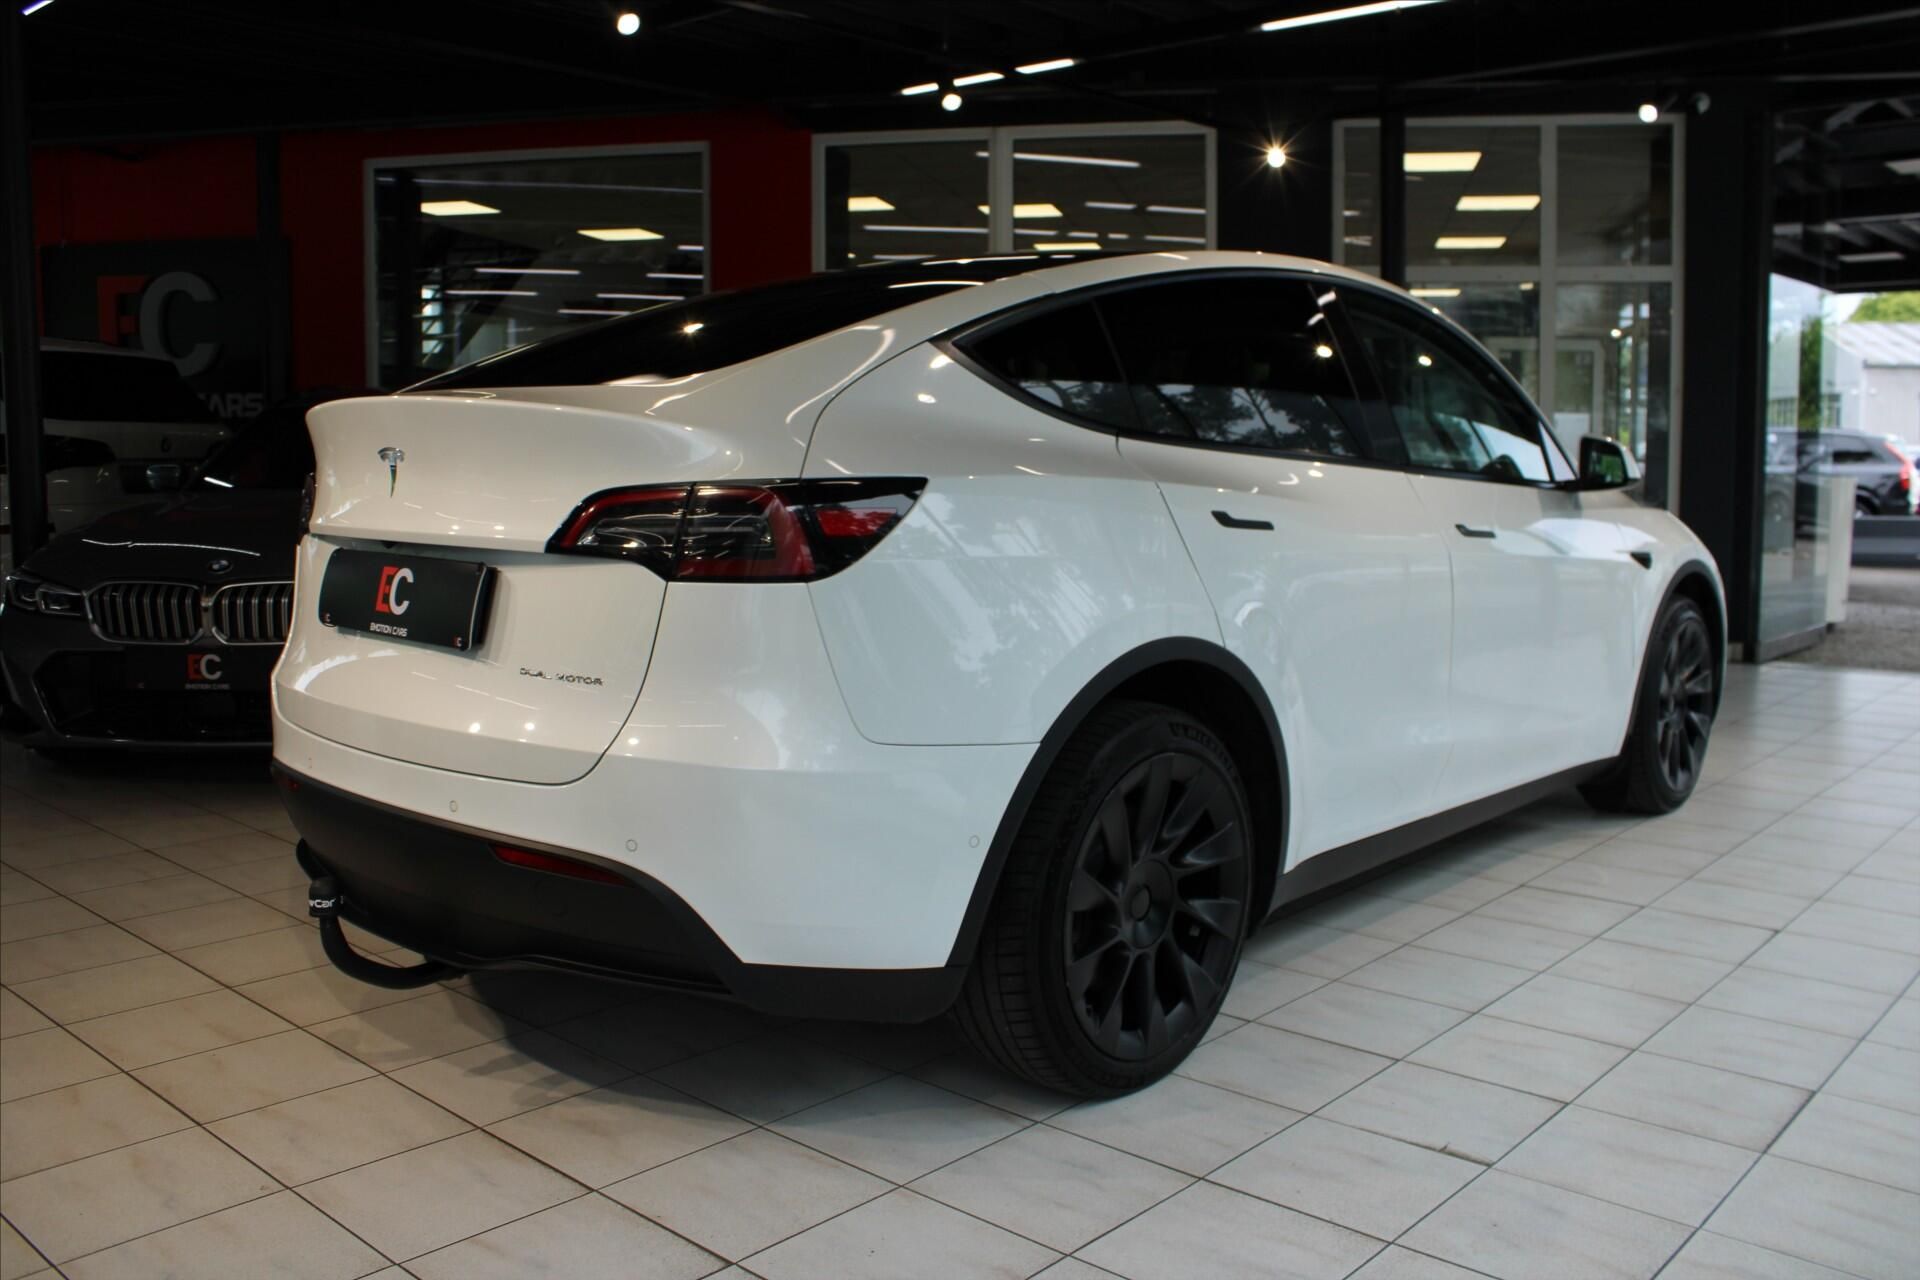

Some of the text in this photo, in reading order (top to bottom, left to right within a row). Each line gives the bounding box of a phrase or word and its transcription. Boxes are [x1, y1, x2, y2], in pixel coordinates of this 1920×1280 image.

[197, 392, 263, 418] ARS
[375, 566, 414, 616] EC
[187, 654, 222, 680] EC
